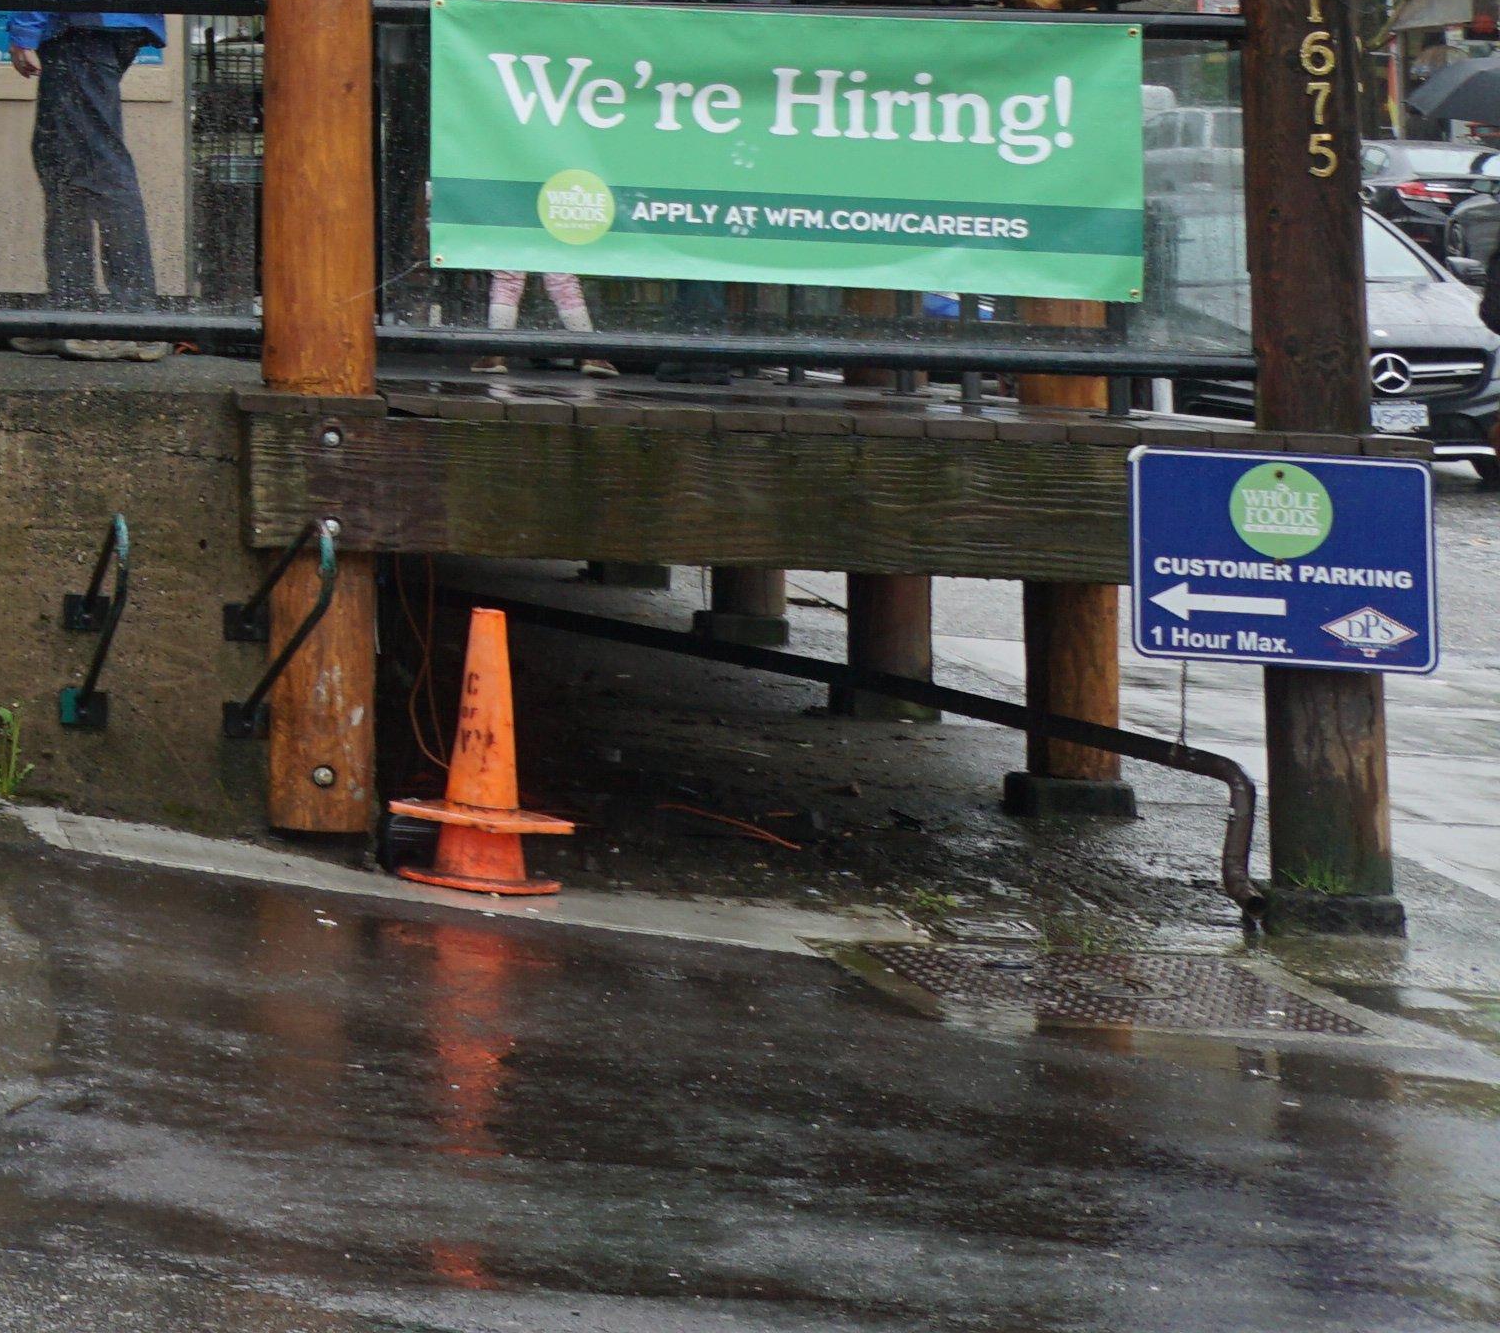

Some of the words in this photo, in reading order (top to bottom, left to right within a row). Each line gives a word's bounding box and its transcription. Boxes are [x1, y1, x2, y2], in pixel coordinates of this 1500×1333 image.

[768, 67, 1074, 165] Hiring!
[545, 184, 607, 206] WHOLE
[548, 204, 608, 223] FOODS
[631, 201, 719, 225] APPLY
[724, 204, 758, 227] AT
[763, 206, 1030, 239] WFM.COM/CAREERS
[1241, 482, 1321, 510] WHOLE
[1244, 506, 1322, 527] FOODS
[1154, 555, 1293, 582] CUSTOMER
[1298, 564, 1414, 590] PARKING
[1150, 625, 1163, 646] 1
[1171, 627, 1232, 650] Hour
[1236, 630, 1294, 654] Max.
[1346, 614, 1394, 640] DPS
